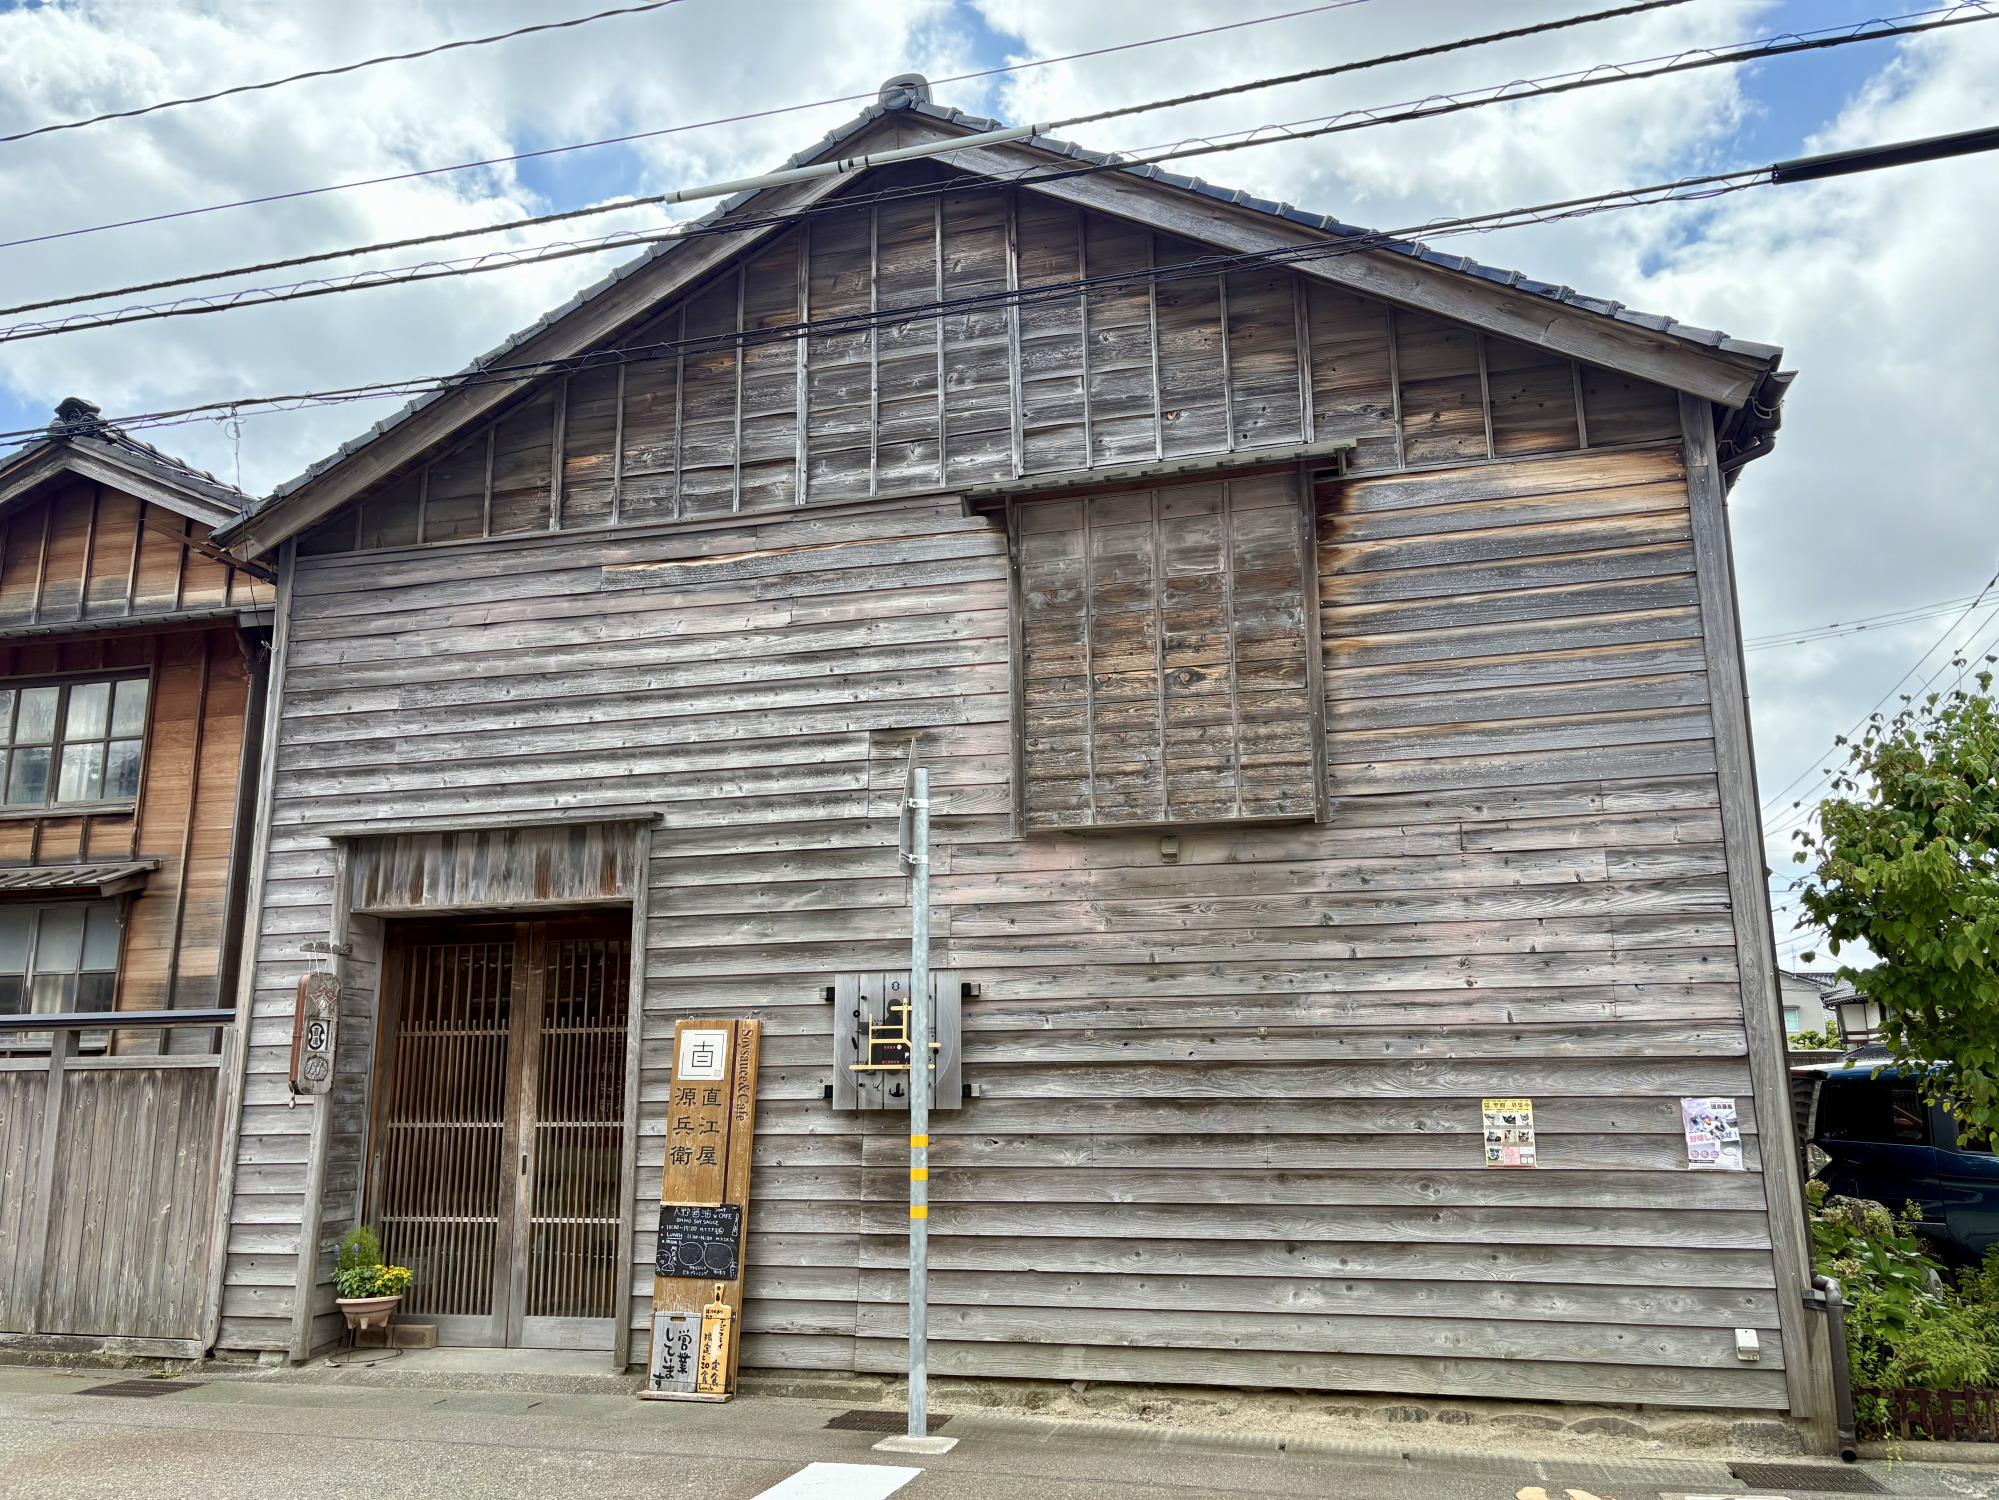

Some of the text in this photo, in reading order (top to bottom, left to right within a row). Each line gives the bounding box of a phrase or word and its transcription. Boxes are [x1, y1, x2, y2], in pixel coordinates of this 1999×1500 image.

[669, 1087, 697, 1166] 源兵衛
[696, 1087, 722, 1166] 直江屋
[677, 1328, 693, 1375] 営業
